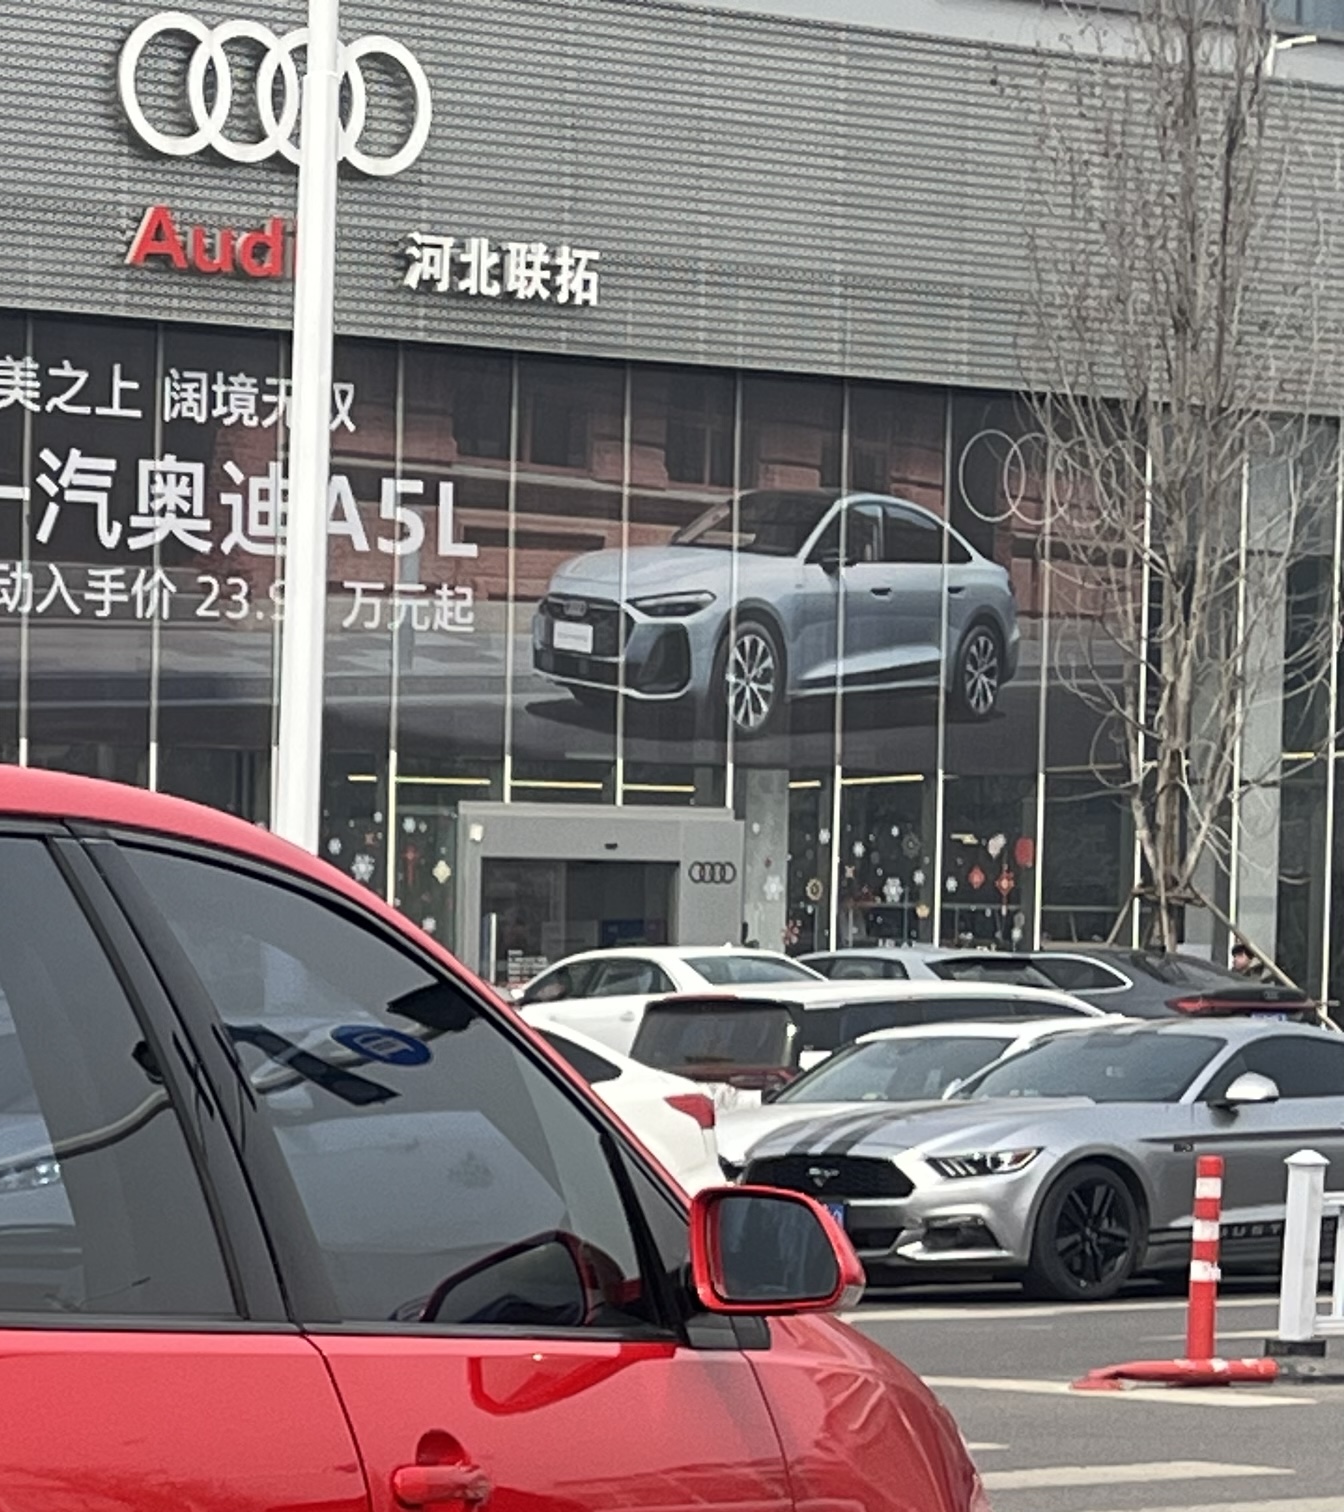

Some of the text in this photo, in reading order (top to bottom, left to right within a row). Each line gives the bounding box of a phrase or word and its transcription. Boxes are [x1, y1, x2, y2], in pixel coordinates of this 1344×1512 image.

[126, 205, 297, 278] Aud
[403, 231, 600, 306] 河北联拓
[195, 575, 288, 622] 23.9
[341, 582, 476, 633] 万元起
